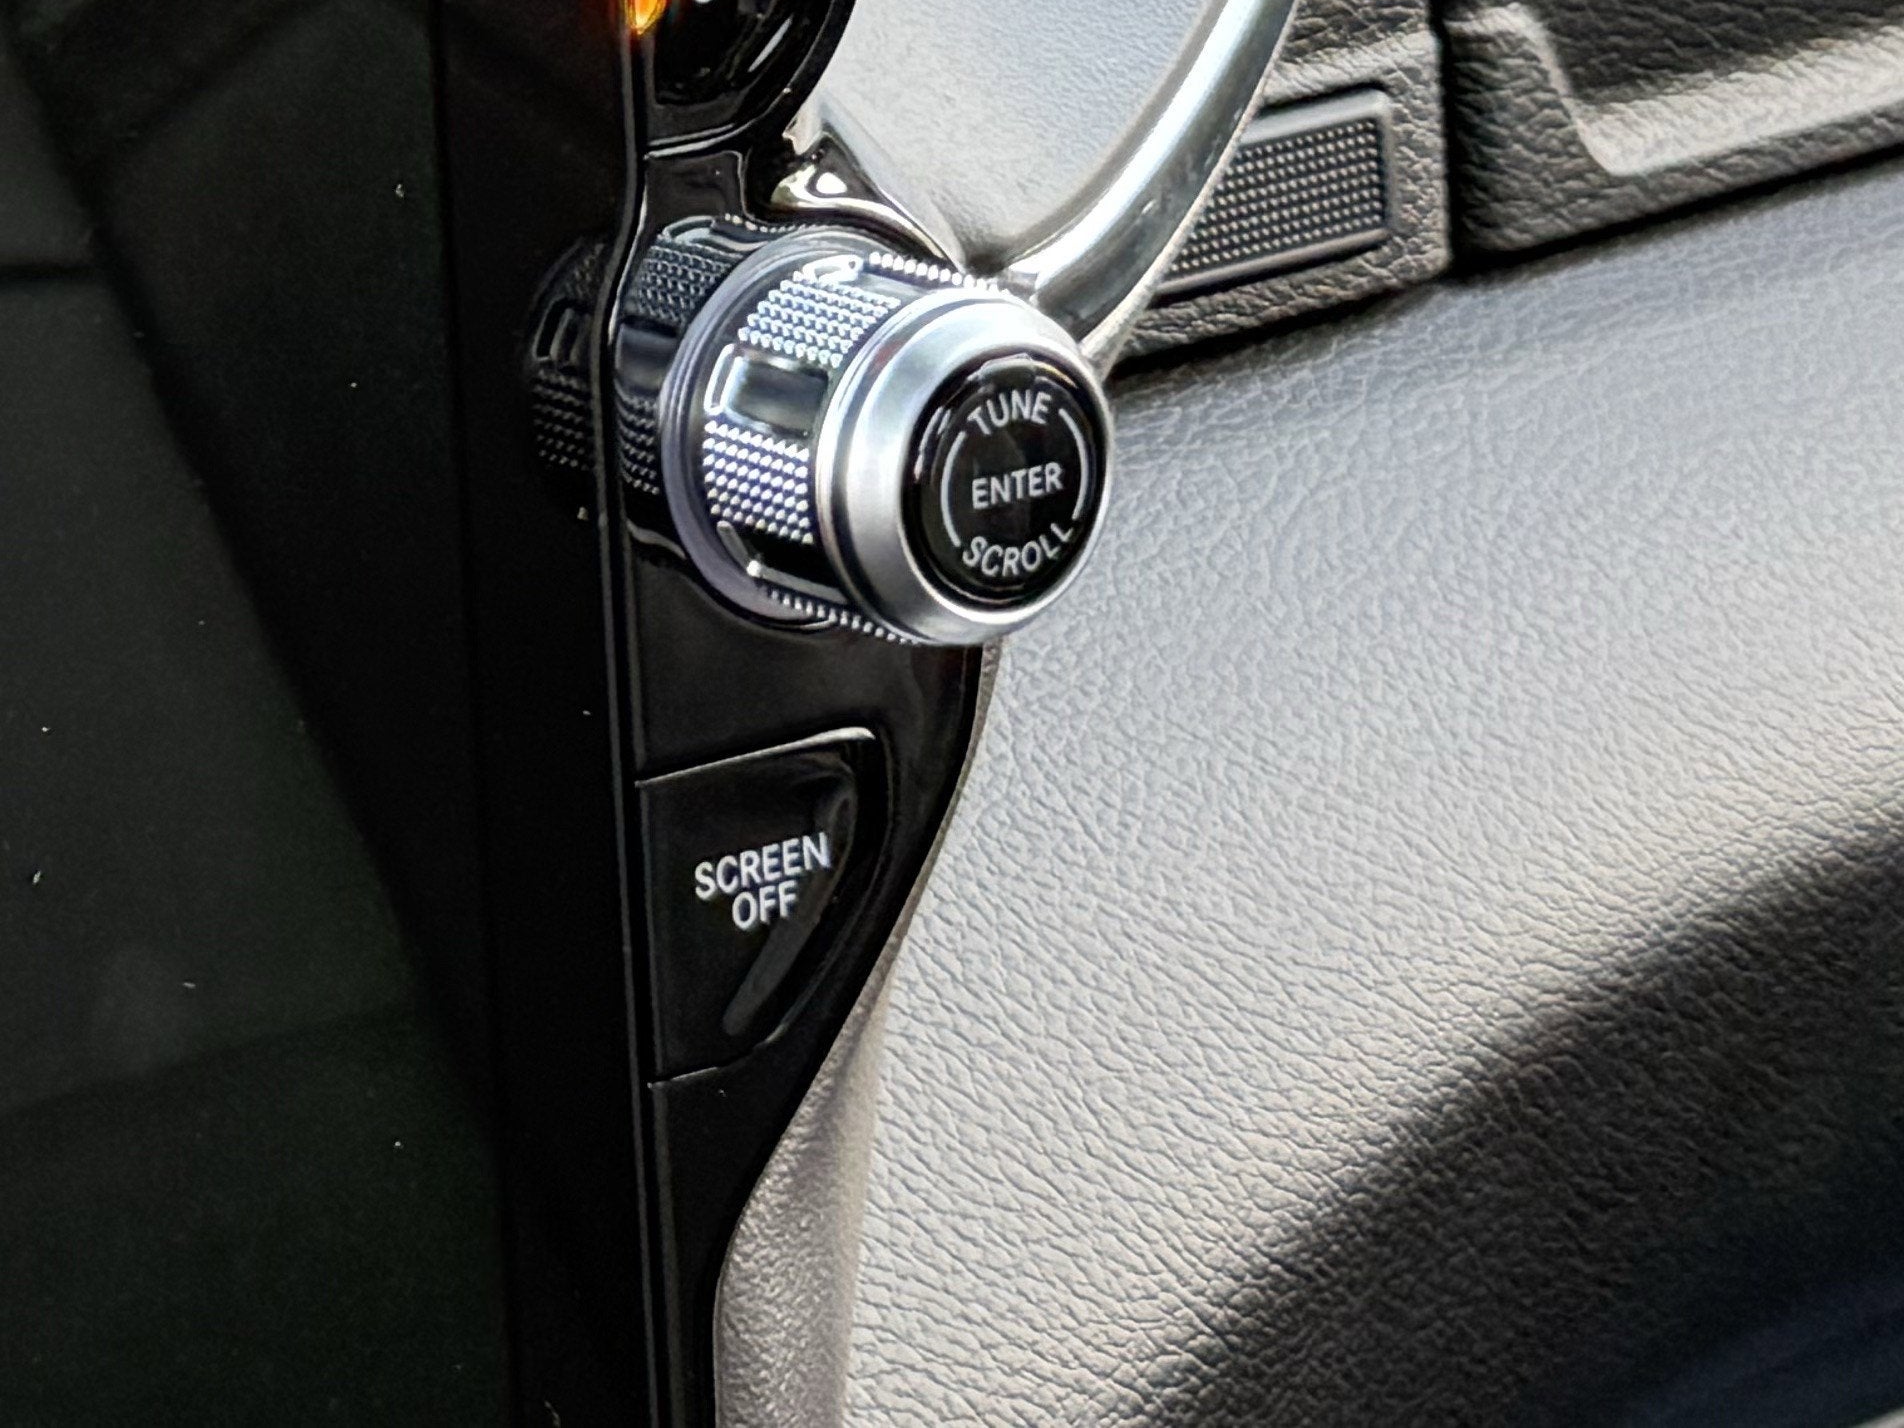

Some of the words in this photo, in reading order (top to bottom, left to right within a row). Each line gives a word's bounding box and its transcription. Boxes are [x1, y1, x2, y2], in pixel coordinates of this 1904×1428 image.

[967, 389, 1052, 436] TUNE
[972, 461, 1065, 510] ENTER
[962, 520, 1074, 577] SCROLL
[695, 832, 832, 902] SCREEN
[732, 880, 798, 932] OFF
